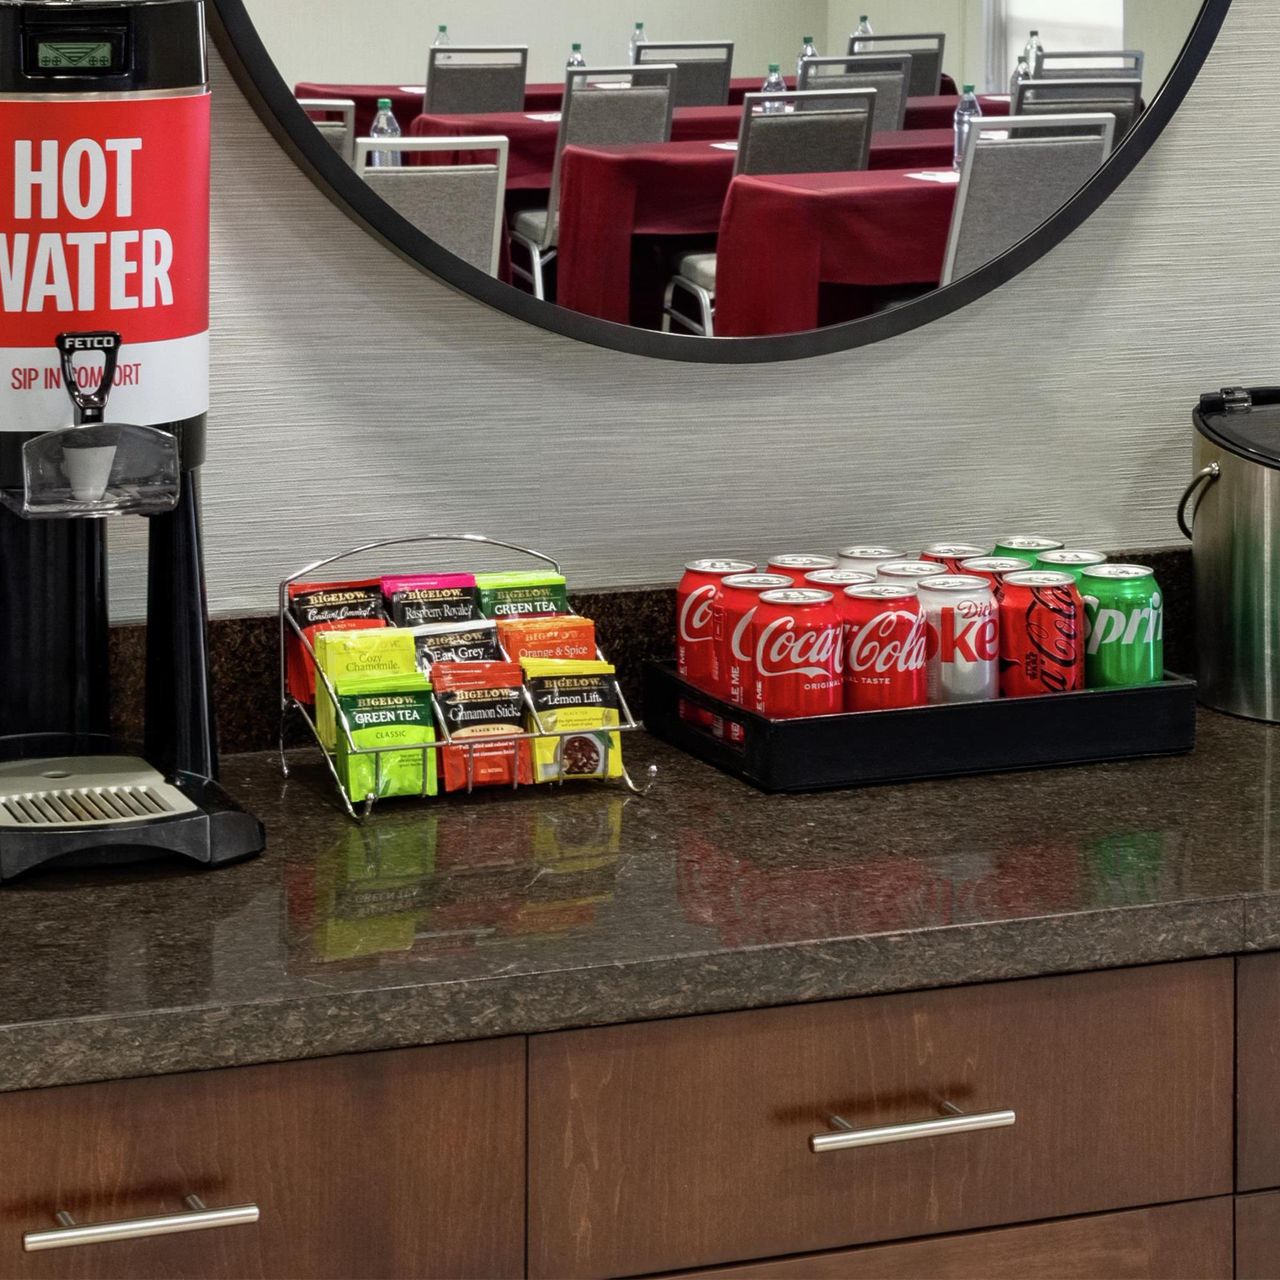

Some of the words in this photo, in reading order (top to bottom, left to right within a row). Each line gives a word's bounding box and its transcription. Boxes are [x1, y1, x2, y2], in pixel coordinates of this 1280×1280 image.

[14, 138, 142, 220] HOT
[65, 336, 114, 349] FETCO
[11, 368, 39, 390] SIP
[44, 368, 61, 389] IN
[308, 591, 366, 605] BIGELOW
[408, 589, 462, 600] BIGELOW
[497, 588, 551, 599] BIGELOW
[495, 602, 534, 615] GREEN
[536, 601, 557, 612] TEA
[458, 647, 484, 660] Grey
[555, 647, 563, 656] &
[564, 645, 588, 658] Spice
[359, 653, 382, 663] Cozy
[544, 677, 601, 688] BIGELOW
[803, 681, 841, 691] ORIGINAL
[861, 677, 891, 685] TASTE
[456, 689, 511, 701] BIGELOW
[548, 694, 581, 705] Lemon
[357, 696, 416, 707] BIGELOW
[355, 711, 395, 724] GREEN
[397, 709, 420, 721] TEA
[450, 707, 495, 721] Cinnamon
[376, 730, 406, 739] CLASSIC
